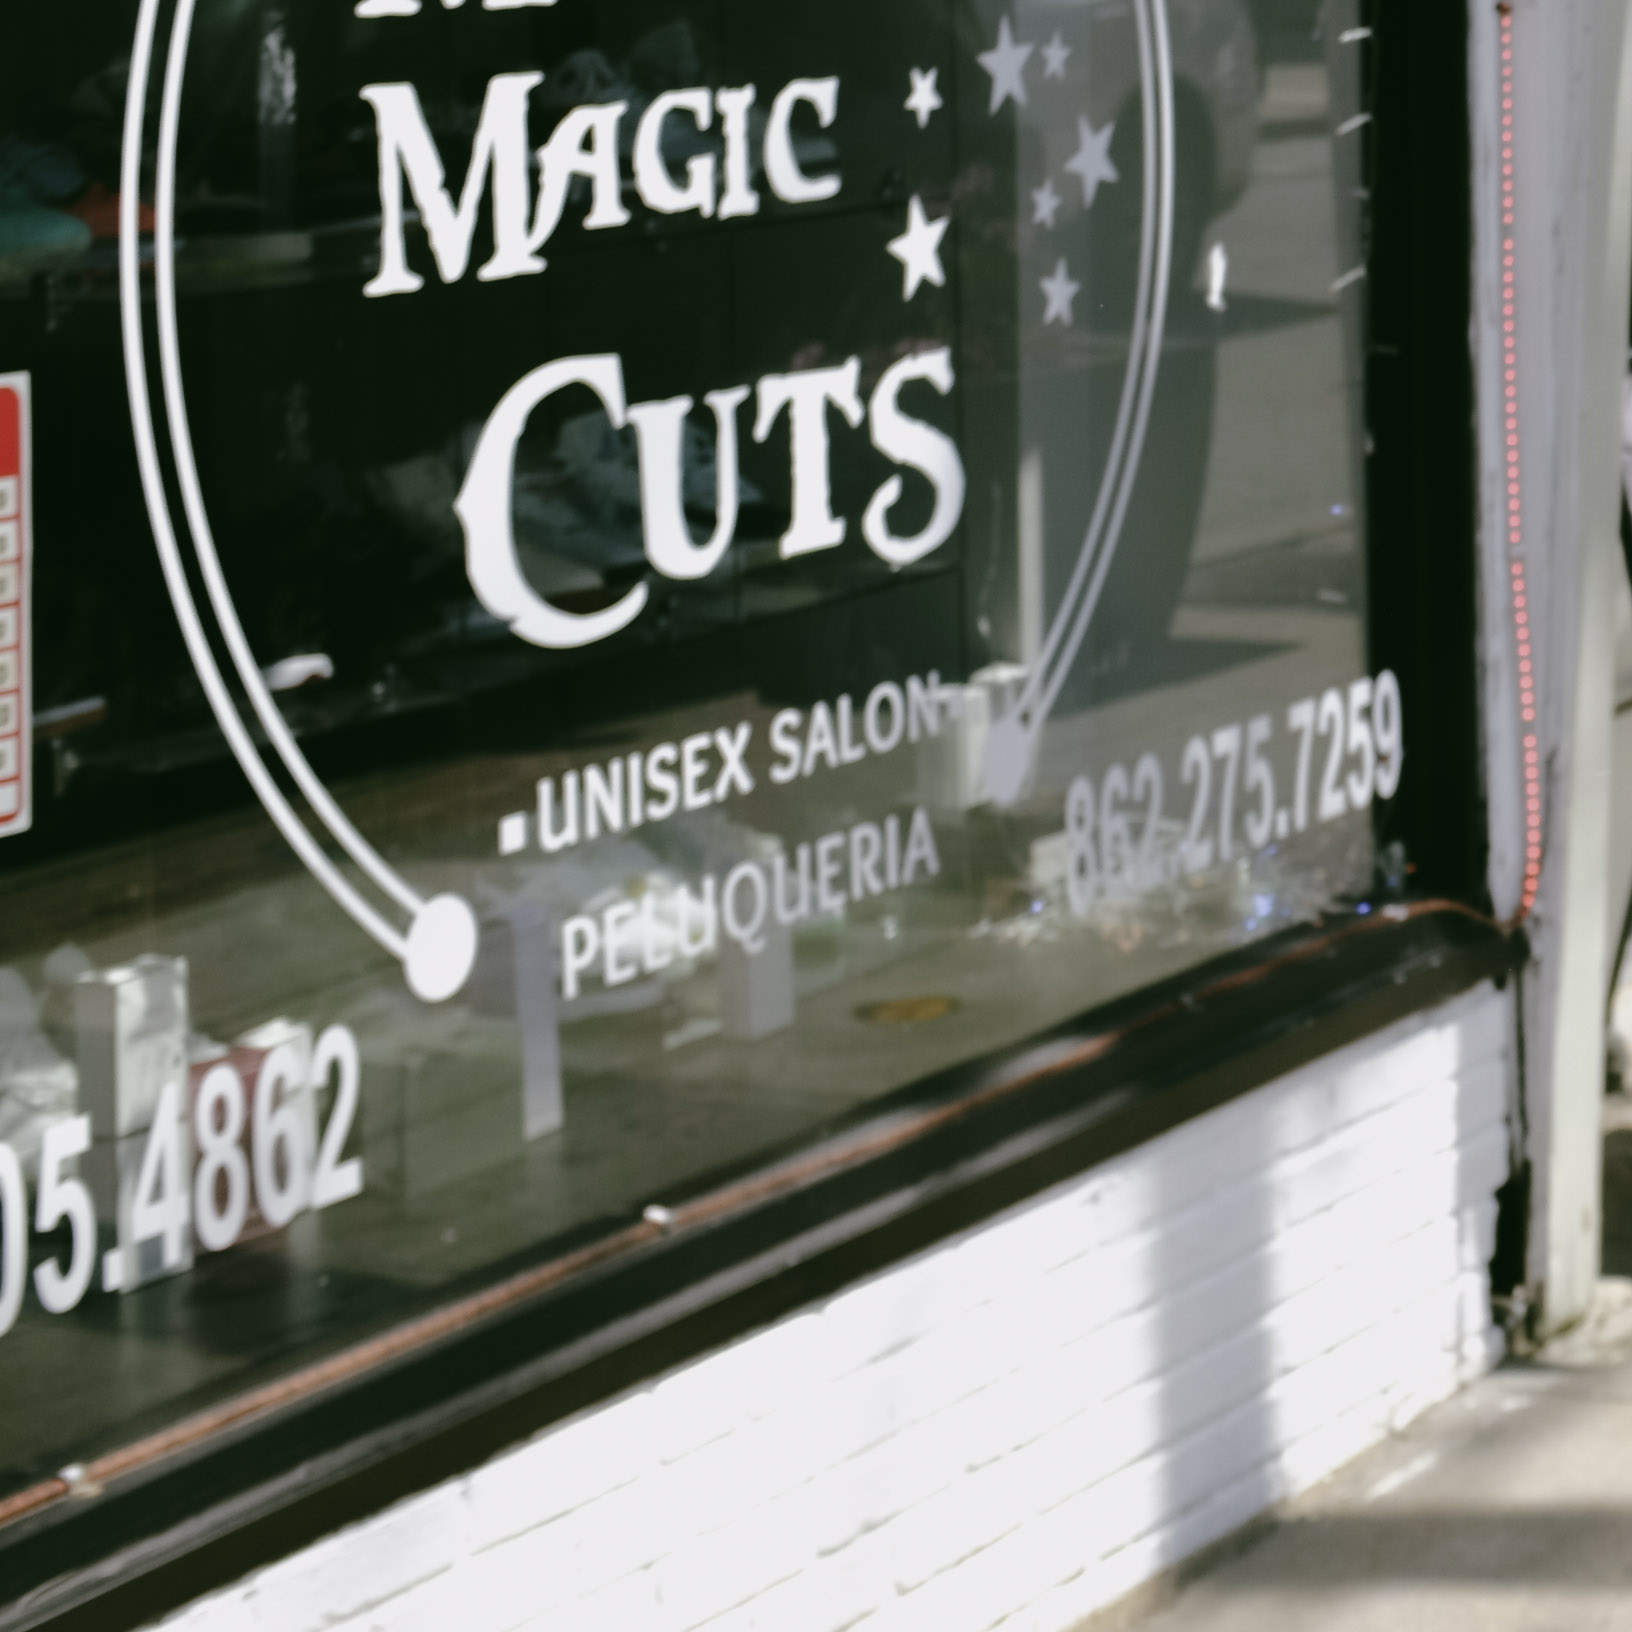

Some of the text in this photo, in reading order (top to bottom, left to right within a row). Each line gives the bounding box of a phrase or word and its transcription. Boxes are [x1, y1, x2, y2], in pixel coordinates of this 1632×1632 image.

[360, 70, 842, 298] MAGIC
[453, 347, 966, 650] CUTS
[537, 668, 944, 853] UNISEX SALON
[1065, 668, 1405, 918] 862.275.7259
[560, 805, 941, 1001] PELUQUERIA
